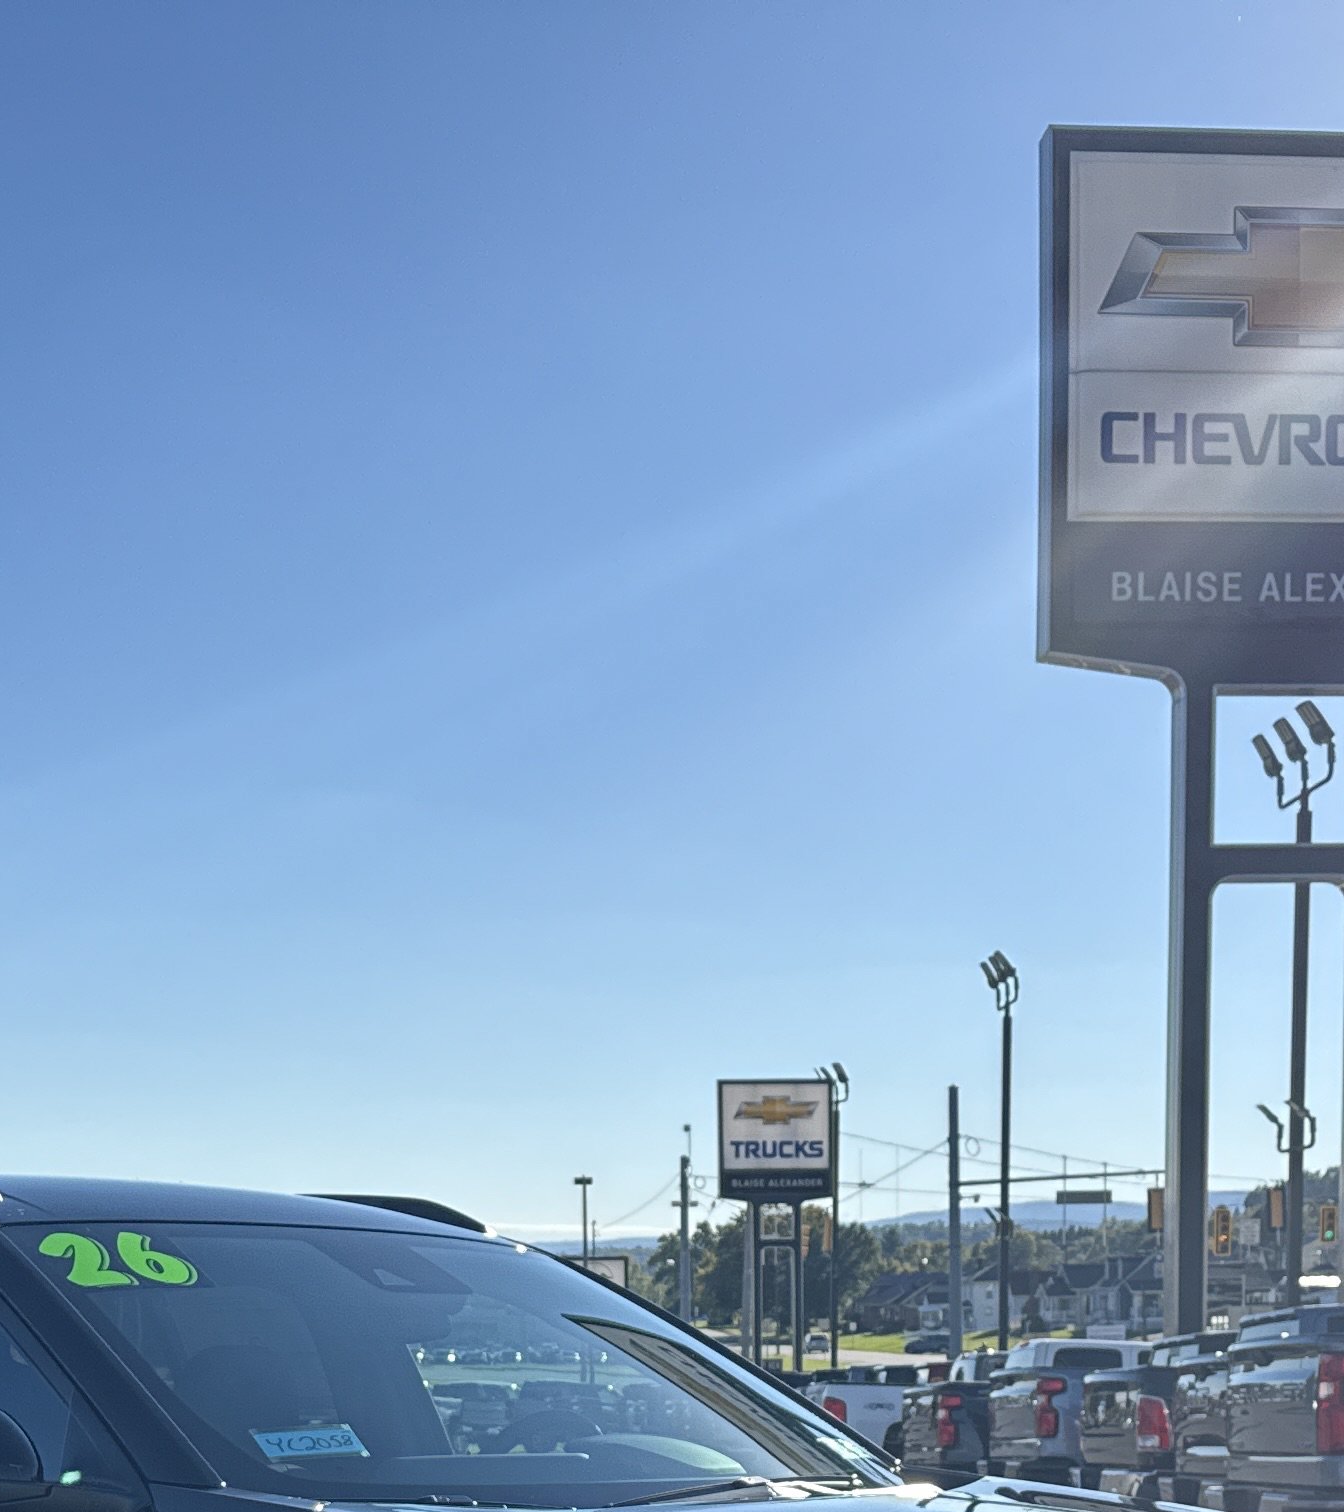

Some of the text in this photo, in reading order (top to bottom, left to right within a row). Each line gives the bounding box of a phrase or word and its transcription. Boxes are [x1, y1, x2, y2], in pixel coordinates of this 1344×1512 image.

[1110, 570, 1243, 602] BLAISE
[730, 1140, 824, 1158] TRUCKS
[732, 1178, 823, 1188] BLAISE ALEXANDER
[38, 1231, 198, 1288] 26
[265, 1434, 354, 1453] YC2058
